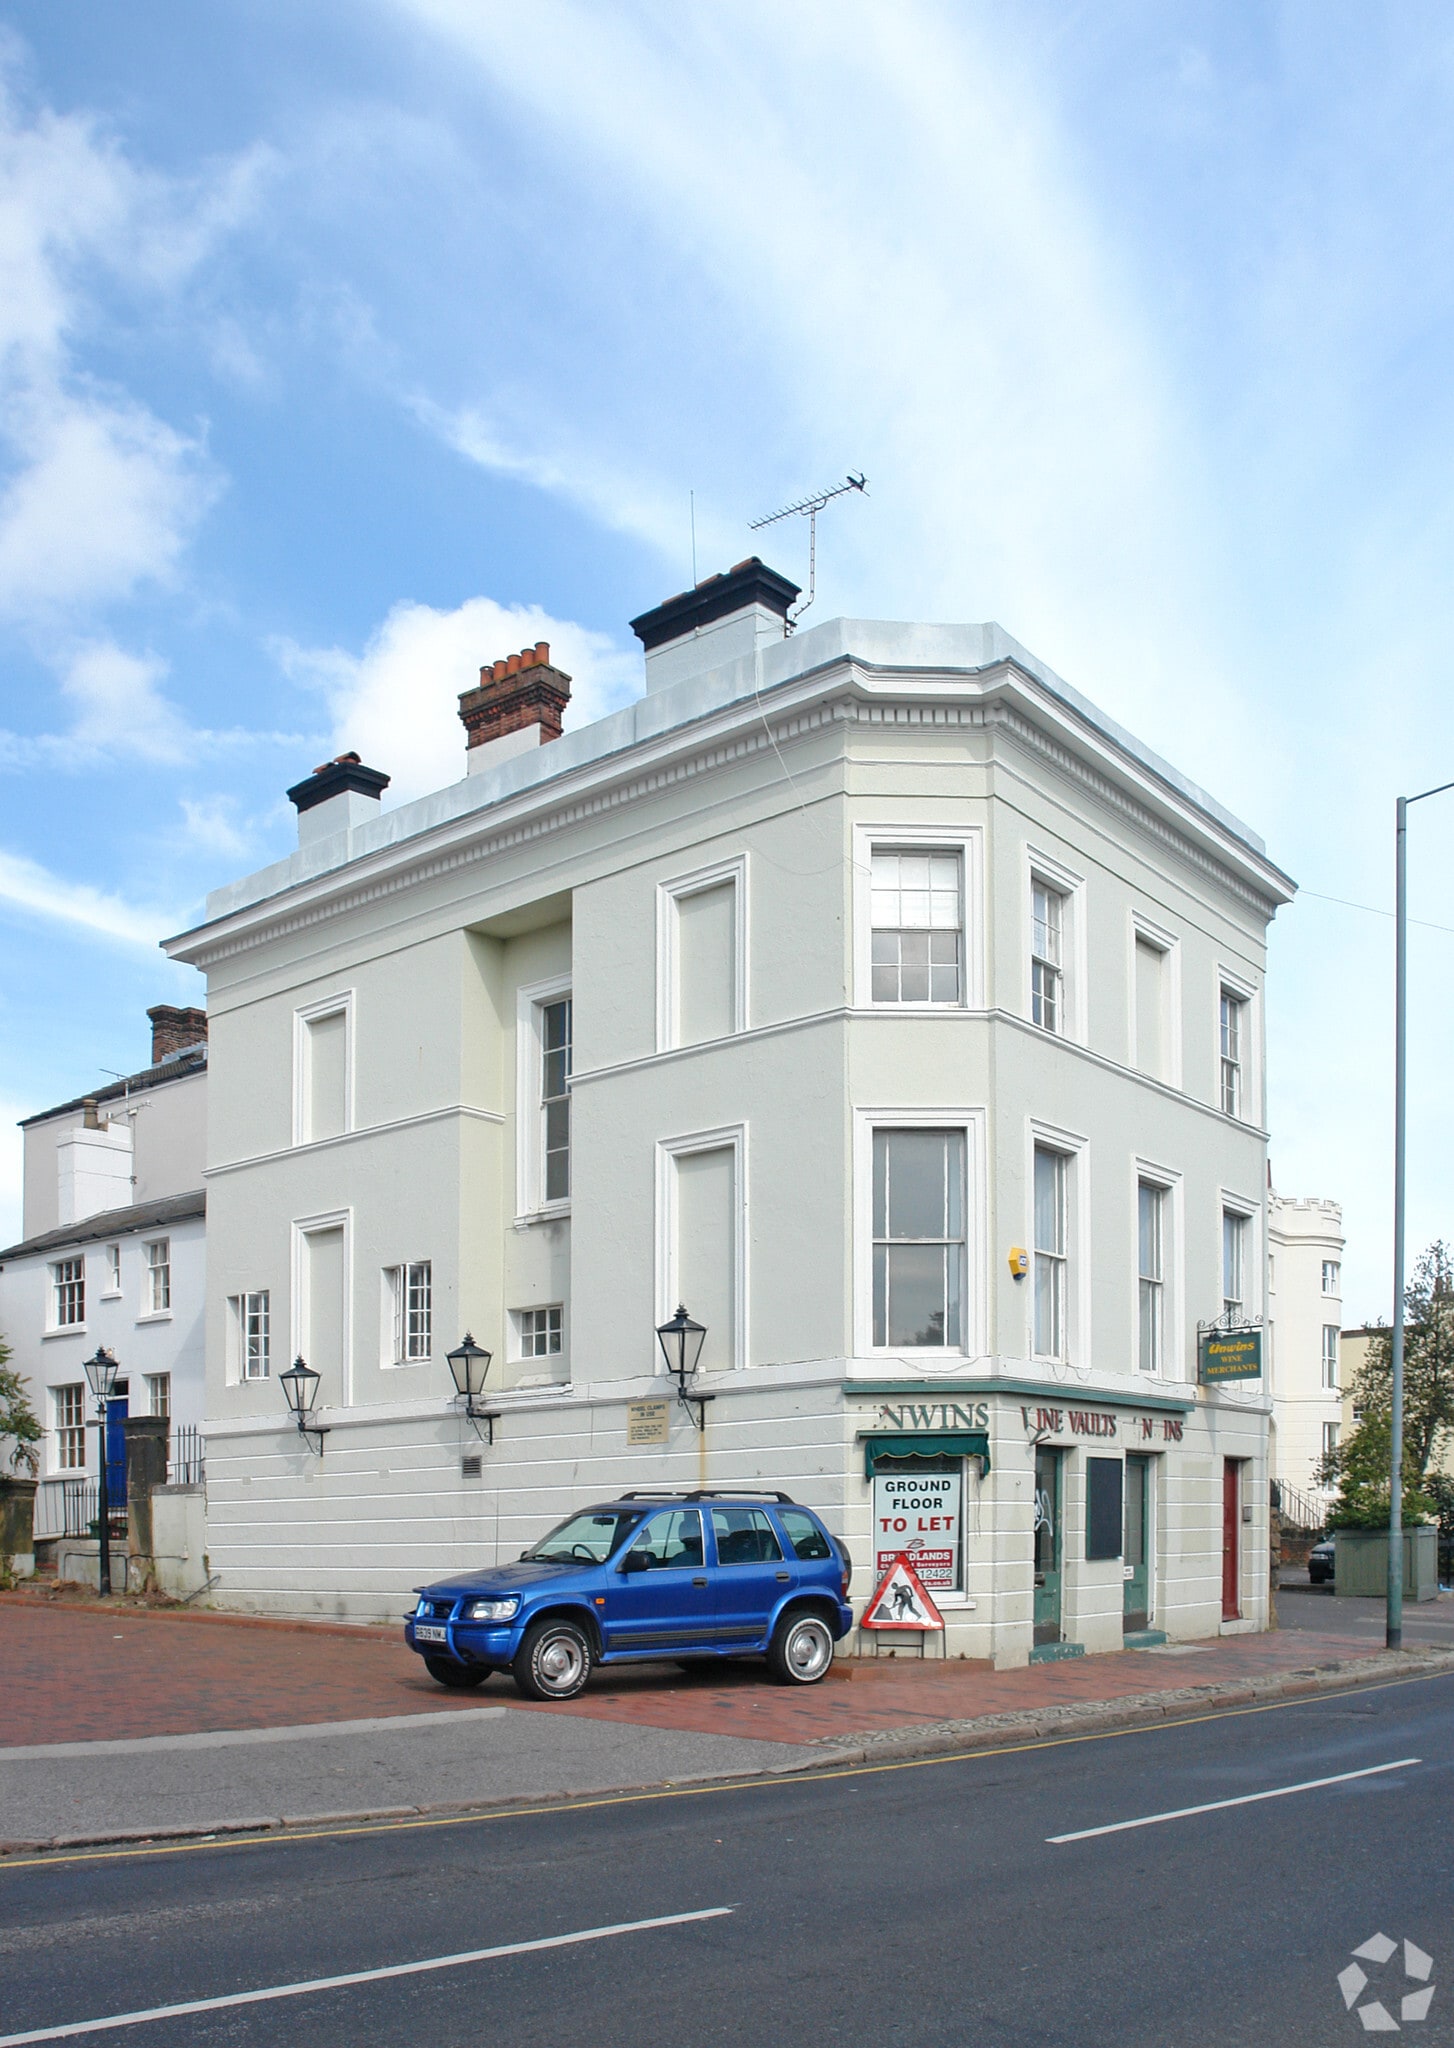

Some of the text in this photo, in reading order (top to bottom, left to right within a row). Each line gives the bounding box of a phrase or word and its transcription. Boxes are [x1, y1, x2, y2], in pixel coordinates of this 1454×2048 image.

[1220, 1355, 1243, 1363] WINE
[1206, 1363, 1258, 1374] MERCHANTS
[1068, 1410, 1117, 1437] VAULTS
[885, 1480, 951, 1492] GROUND
[892, 1498, 943, 1510] FLOOR
[879, 1516, 955, 1532] TO LET
[880, 1552, 951, 1562] BRDLANDS
